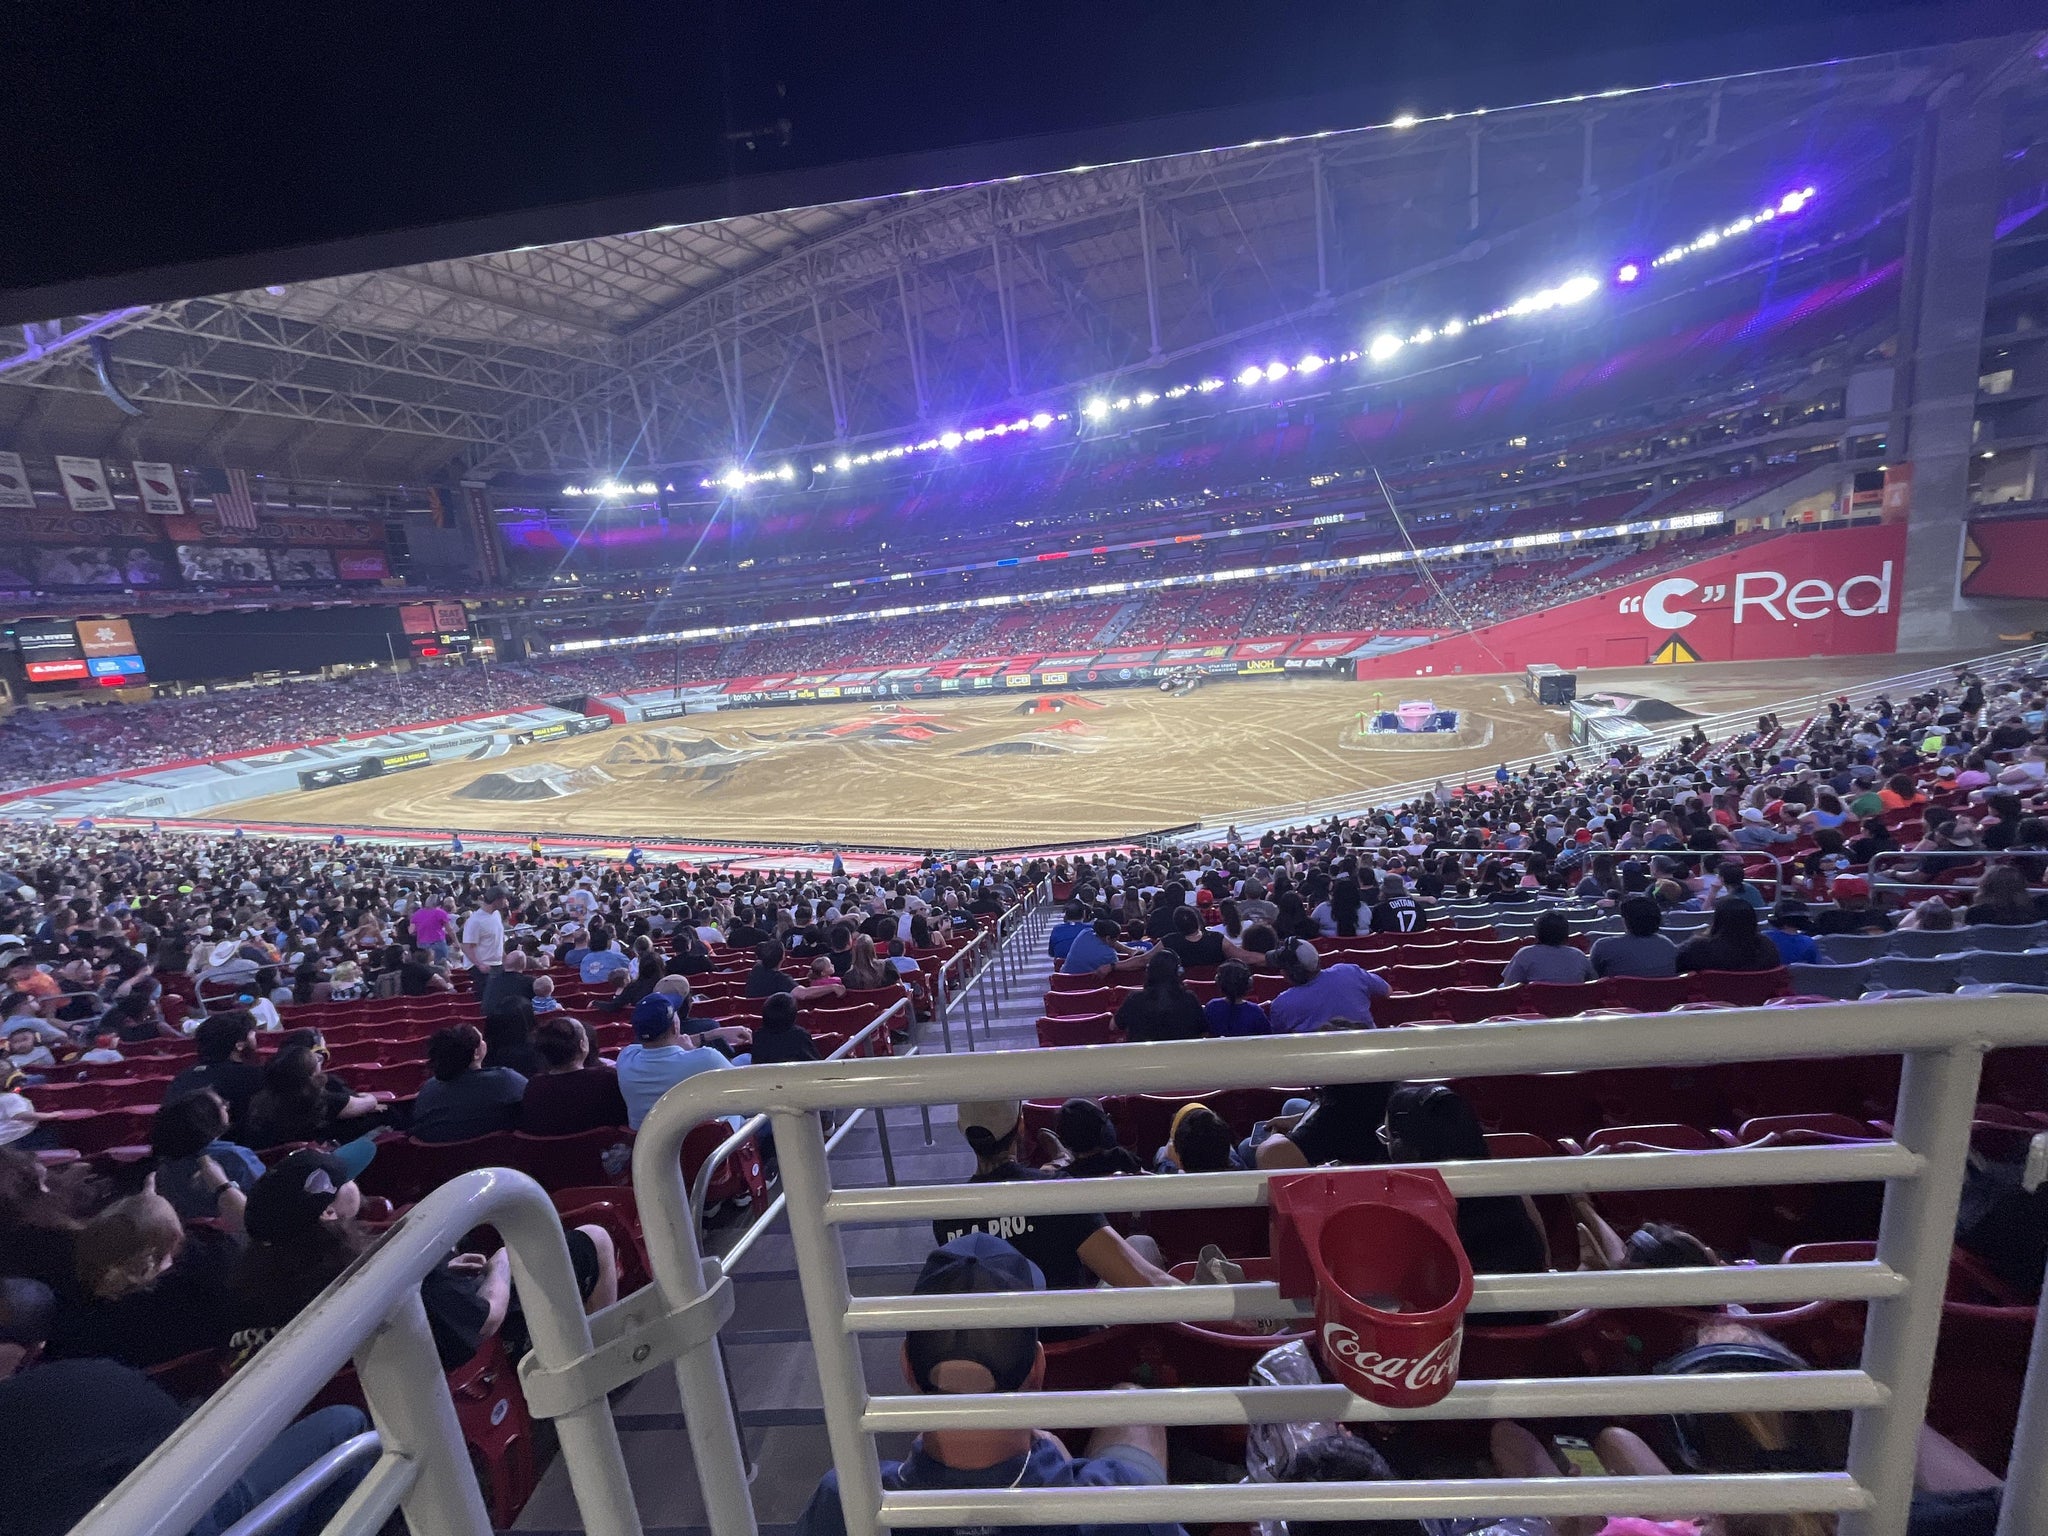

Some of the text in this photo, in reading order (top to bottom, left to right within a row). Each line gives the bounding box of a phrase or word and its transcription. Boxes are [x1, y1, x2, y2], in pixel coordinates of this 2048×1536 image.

[1733, 560, 1893, 624] Red
[1246, 659, 1275, 669] UNOH
[1396, 910, 1417, 933] 17
